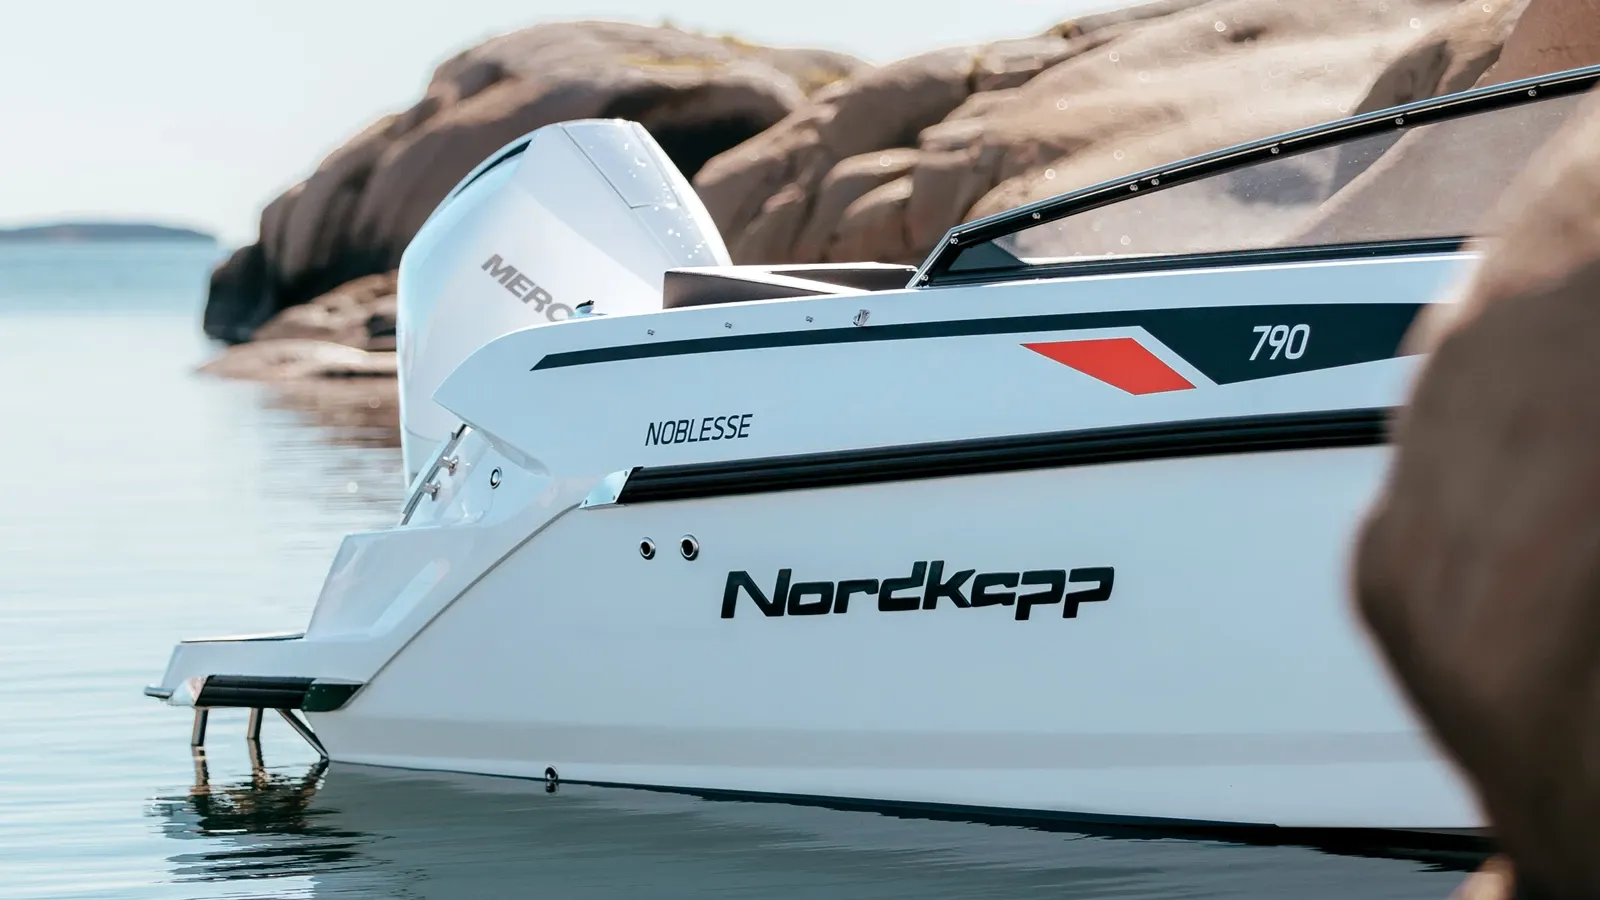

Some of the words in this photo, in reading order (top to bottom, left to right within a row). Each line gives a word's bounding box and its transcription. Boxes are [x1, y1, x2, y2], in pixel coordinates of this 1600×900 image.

[481, 253, 574, 322] MERC
[1249, 323, 1311, 361] 790
[644, 413, 754, 447] NOBLESSE
[720, 560, 1115, 621] Nordkapp
